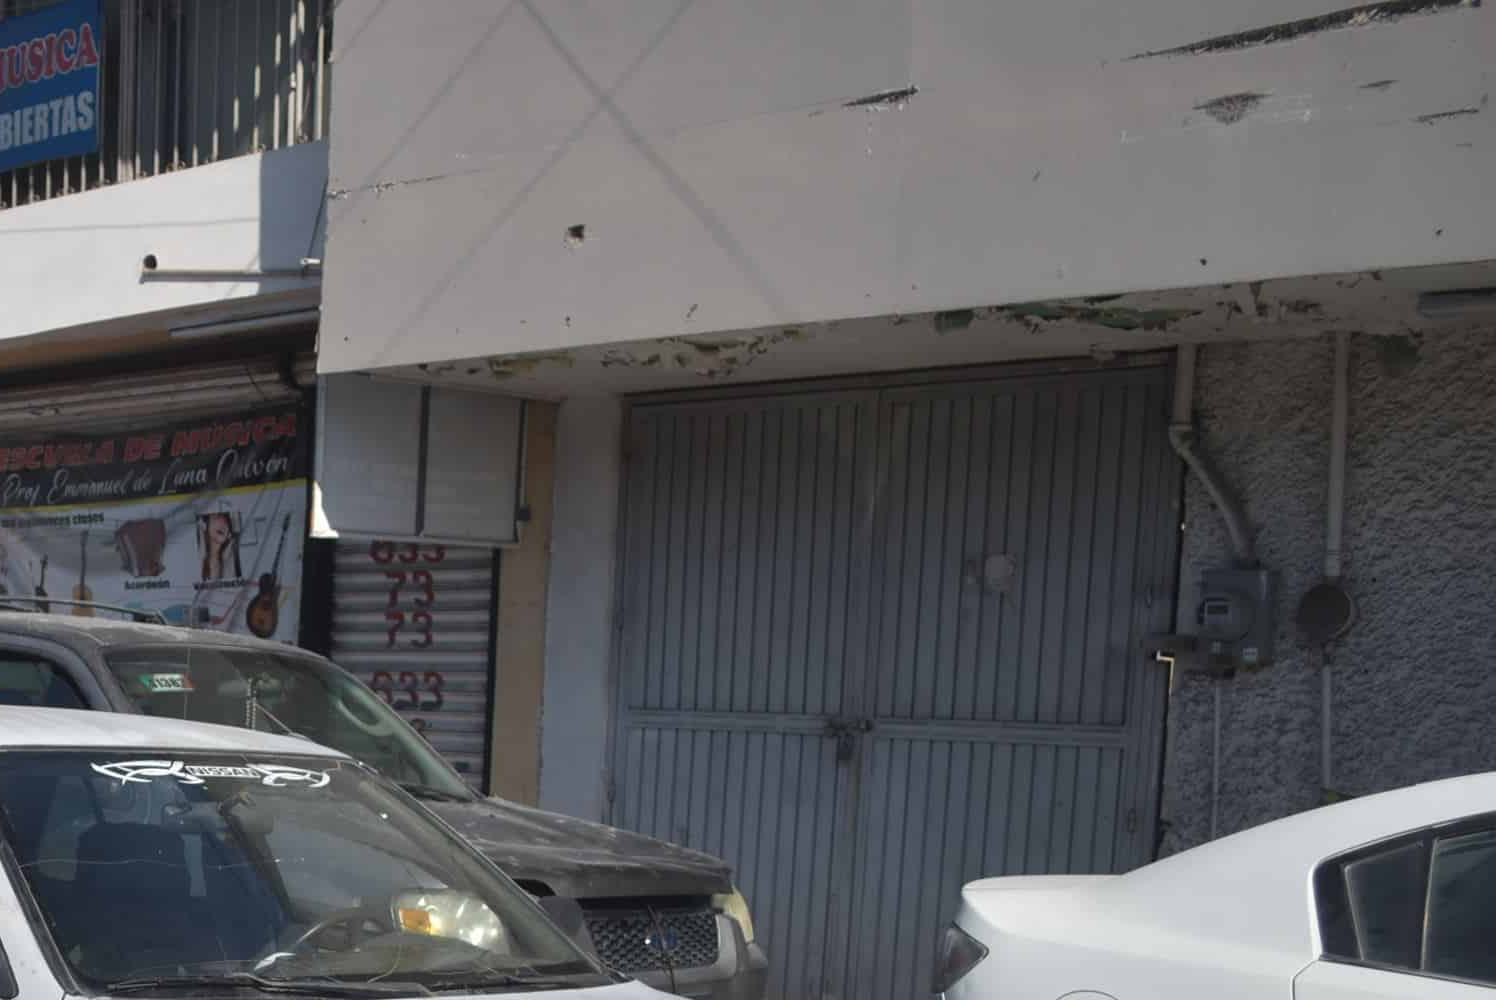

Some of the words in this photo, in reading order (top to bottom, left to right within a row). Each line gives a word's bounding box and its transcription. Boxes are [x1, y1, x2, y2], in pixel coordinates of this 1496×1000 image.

[123, 434, 162, 464] DE
[170, 415, 298, 457] MUSICA
[47, 467, 130, 506] Emmanuel
[132, 472, 153, 492] de
[158, 456, 208, 496] Luna
[382, 569, 435, 609] 73
[384, 609, 434, 649] 73
